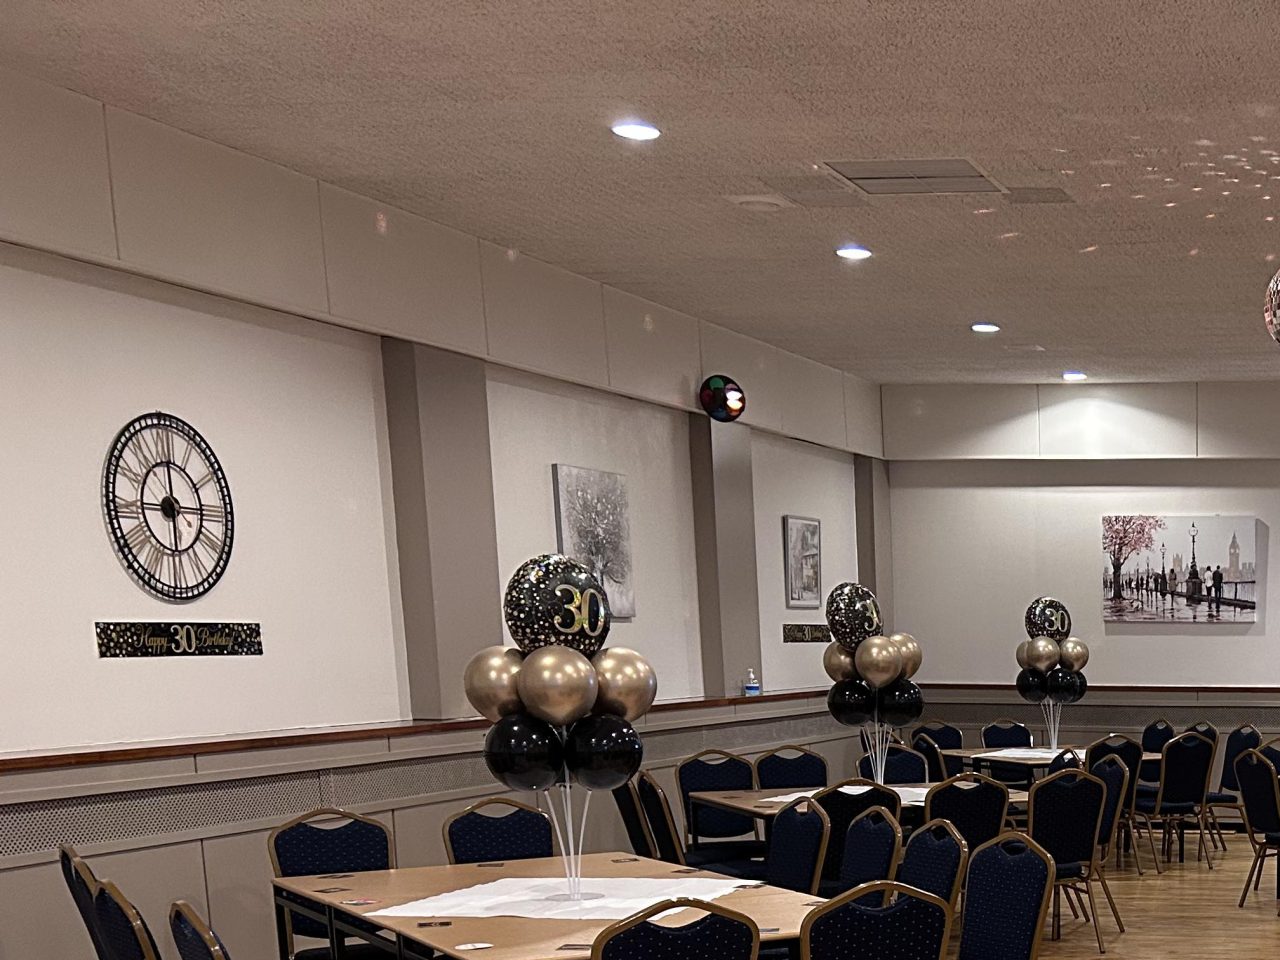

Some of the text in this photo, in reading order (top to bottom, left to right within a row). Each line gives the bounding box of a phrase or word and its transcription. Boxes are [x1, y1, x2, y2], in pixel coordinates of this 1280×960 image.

[554, 584, 605, 637] 30
[1044, 608, 1068, 632] 30
[134, 622, 170, 654] Happy
[170, 624, 196, 653] 30
[802, 625, 812, 641] 30
